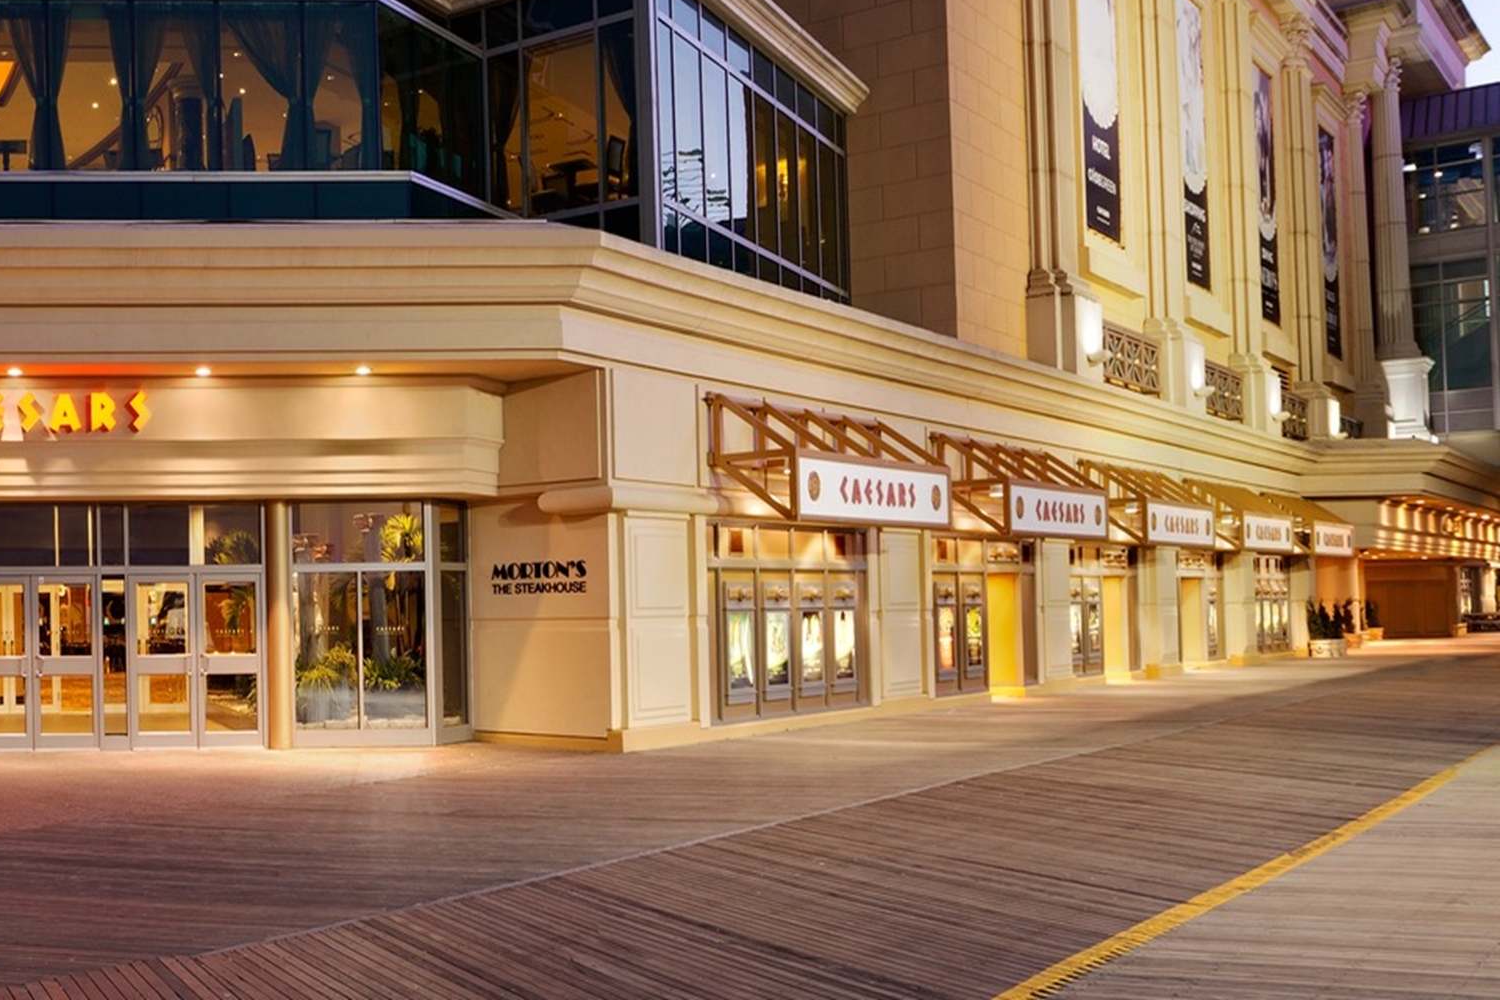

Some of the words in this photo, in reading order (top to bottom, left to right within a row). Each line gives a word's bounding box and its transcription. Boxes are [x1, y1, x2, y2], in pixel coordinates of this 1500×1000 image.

[839, 475, 916, 509] CAESARS
[1035, 498, 1085, 525] CAESARS
[1164, 514, 1200, 536] CAESARS
[491, 559, 588, 581] MORTON'S
[492, 583, 512, 595] THE
[514, 581, 587, 595] STEAKHOUSE
